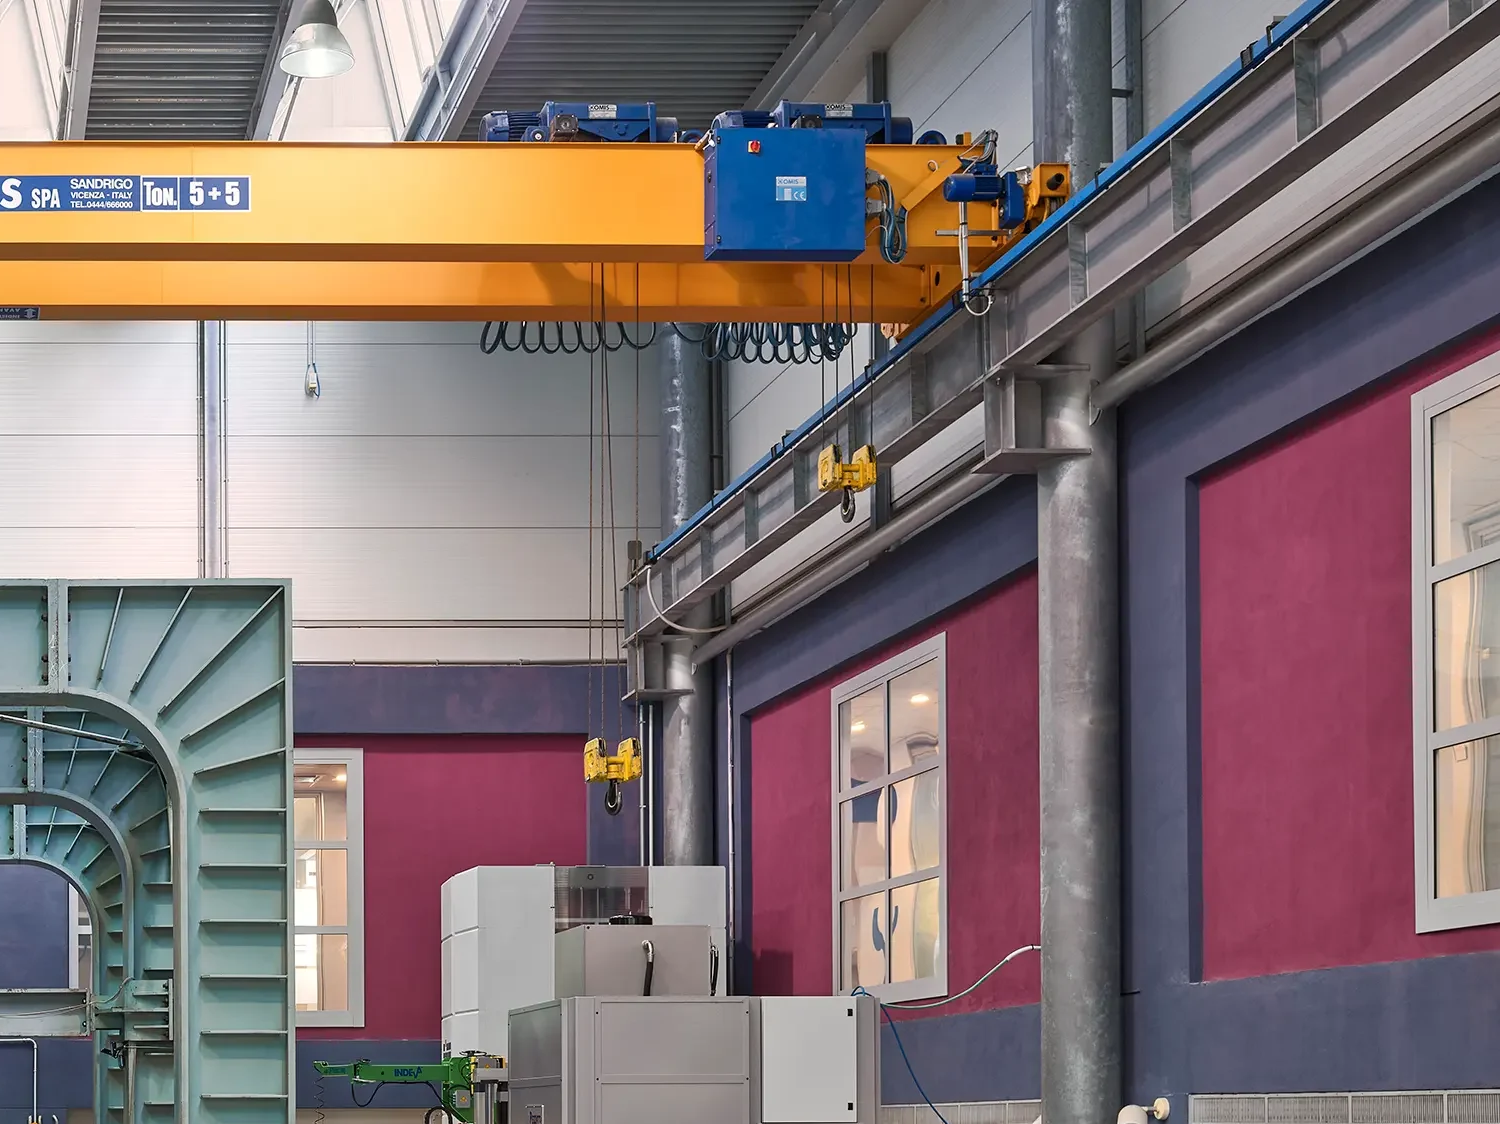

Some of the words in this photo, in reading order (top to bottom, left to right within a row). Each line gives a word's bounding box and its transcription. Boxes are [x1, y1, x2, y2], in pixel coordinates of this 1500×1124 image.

[70, 178, 133, 190] SANDRIGO
[31, 188, 61, 208] SPA
[70, 191, 105, 199] VICENZA
[111, 191, 133, 199] ITALY
